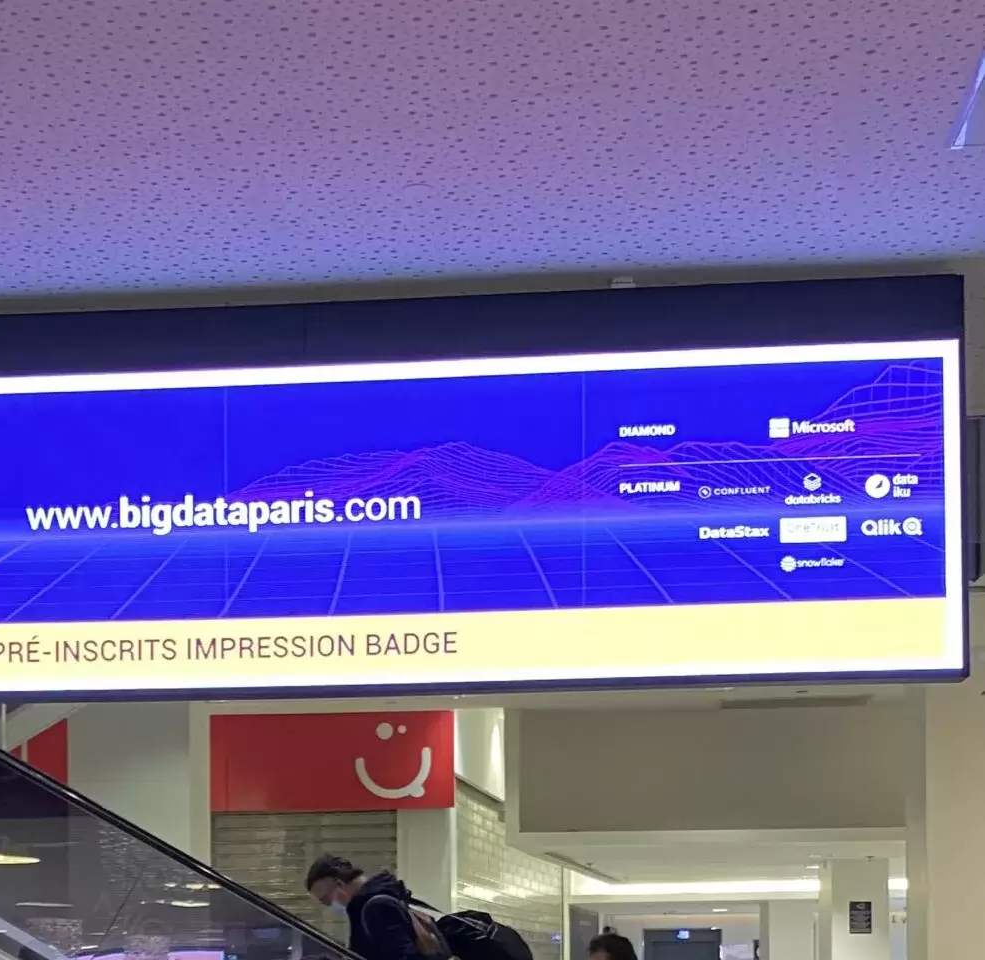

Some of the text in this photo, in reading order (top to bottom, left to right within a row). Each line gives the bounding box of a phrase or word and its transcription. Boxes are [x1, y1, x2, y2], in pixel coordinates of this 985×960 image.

[619, 424, 676, 438] DIAMOND
[792, 418, 856, 435] Microsoft
[892, 473, 919, 485] data
[619, 481, 681, 494] PLATINUM
[713, 485, 771, 496] CONFLUENT
[892, 486, 911, 498] iku
[784, 493, 842, 505] databricks
[25, 490, 422, 535] www.bigdataparis.com
[698, 525, 770, 539] DataStax
[796, 557, 845, 569] snowflake
[186, 634, 356, 660] IMPRESSION
[365, 630, 458, 656] BADGE
